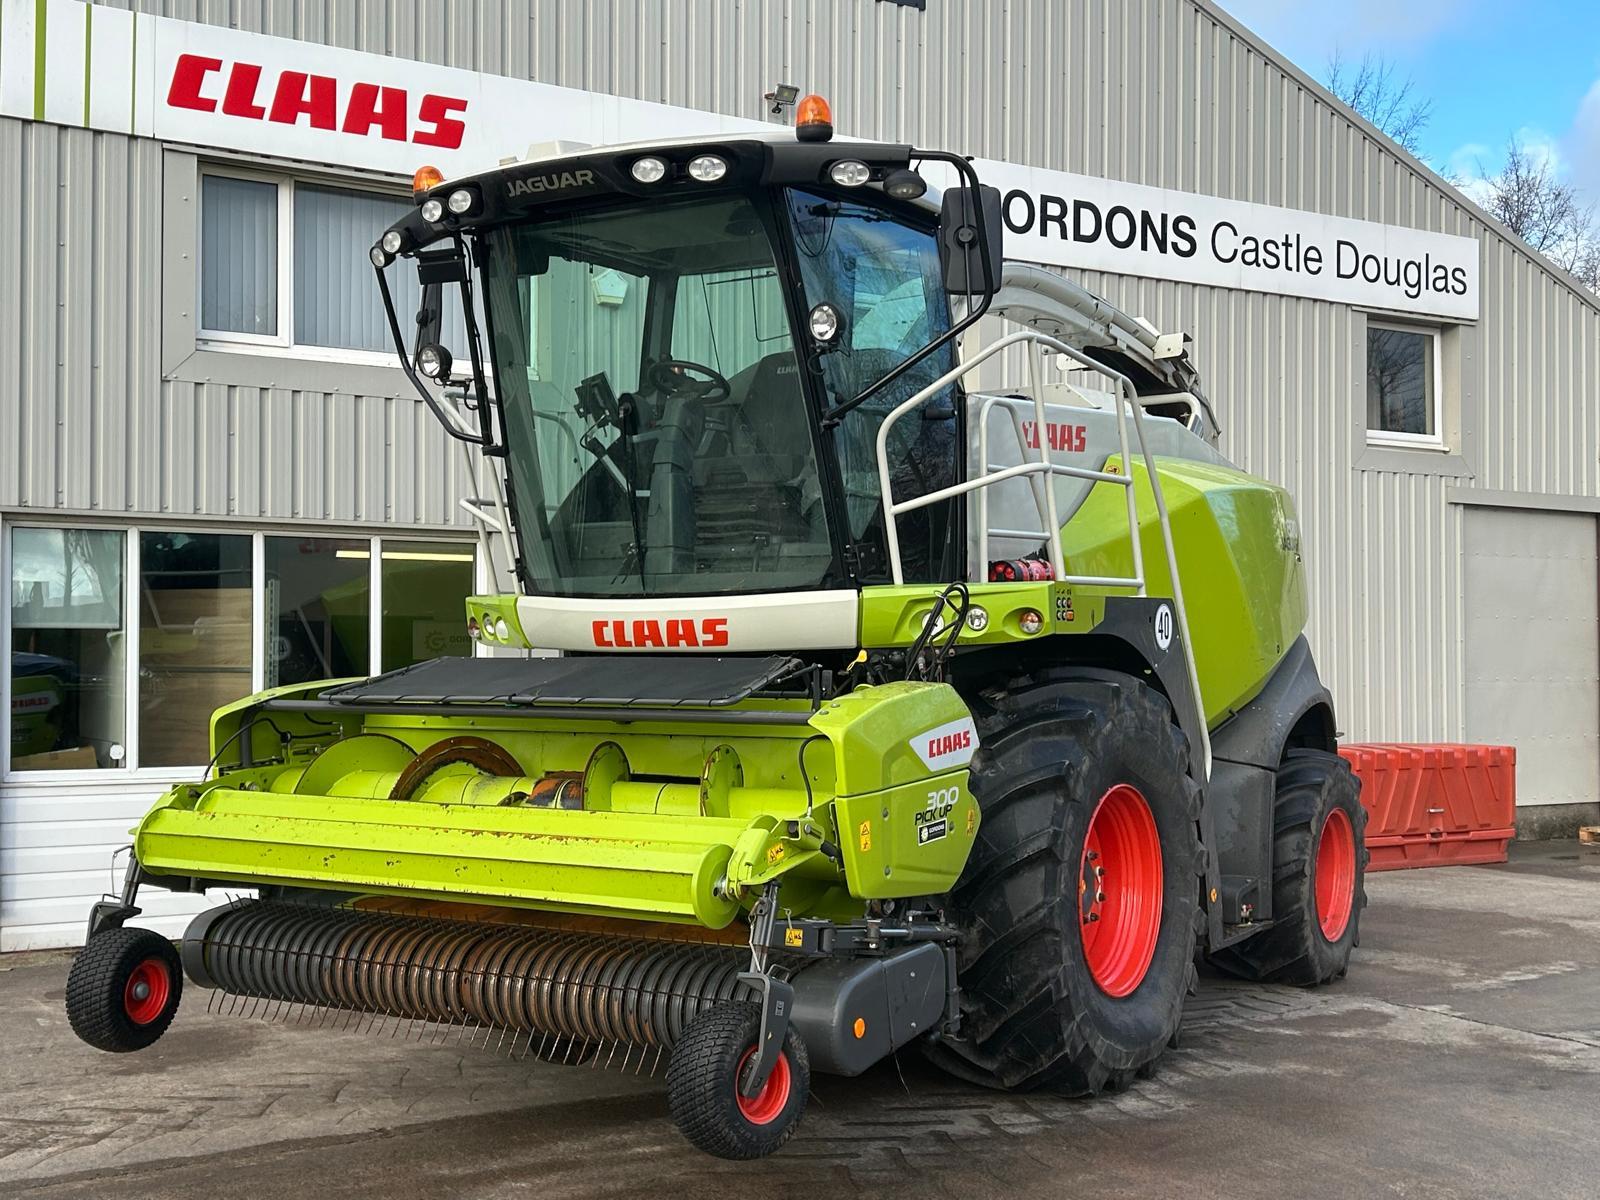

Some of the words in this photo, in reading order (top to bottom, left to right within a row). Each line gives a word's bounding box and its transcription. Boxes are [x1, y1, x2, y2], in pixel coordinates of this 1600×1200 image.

[166, 53, 469, 150] CLAAS
[507, 169, 595, 198] JAGUAR
[1002, 189, 1197, 258] ORDONS
[1211, 221, 1323, 276] Castle
[1336, 239, 1468, 299] Douglas
[592, 618, 729, 648] CLAAS
[1158, 611, 1170, 640] 40
[928, 730, 970, 758] CLAAS
[927, 786, 959, 810] 300
[915, 809, 937, 825] PICK
[938, 804, 953, 818] UP
